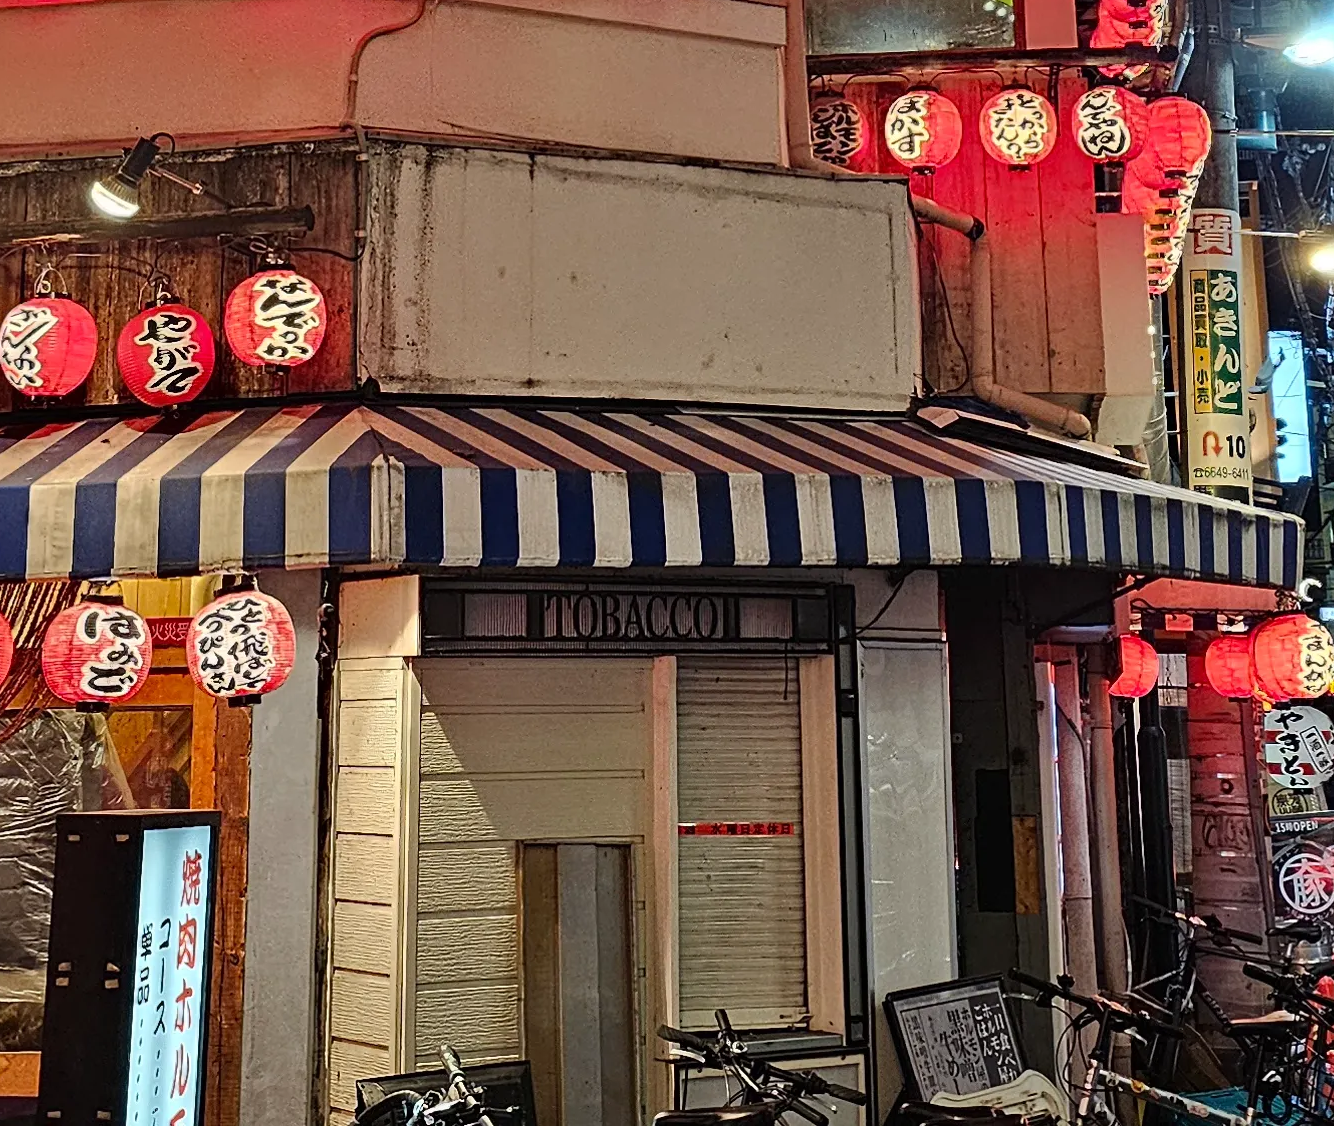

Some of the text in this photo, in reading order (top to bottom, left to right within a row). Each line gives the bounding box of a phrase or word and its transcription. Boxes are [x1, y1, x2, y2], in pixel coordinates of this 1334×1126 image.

[1193, 213, 1233, 256] 質
[1192, 277, 1211, 405] 商品買取・小売
[1210, 272, 1242, 411] あきんど
[1226, 434, 1246, 459] 10
[78, 609, 144, 697] はみご
[544, 593, 719, 640] TOBACCO
[1273, 710, 1310, 788] やきとん
[153, 917, 172, 1036] コース
